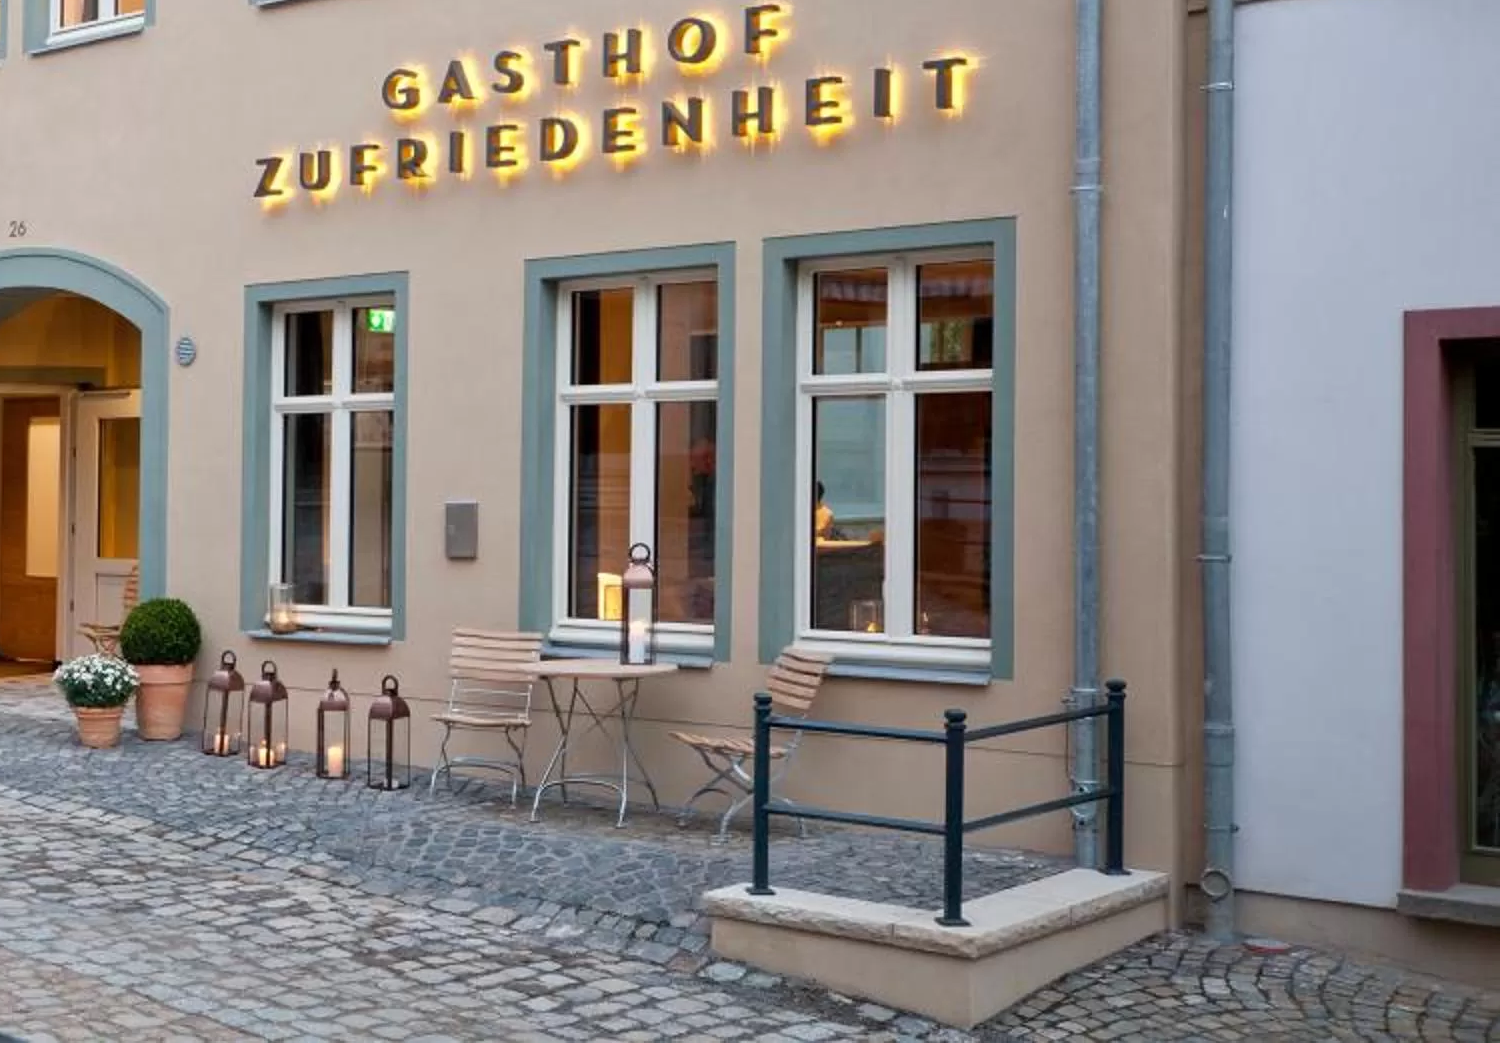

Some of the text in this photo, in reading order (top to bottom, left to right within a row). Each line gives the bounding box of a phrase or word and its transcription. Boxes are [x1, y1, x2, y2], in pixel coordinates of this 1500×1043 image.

[382, 3, 781, 110] GASTHOF
[253, 57, 968, 198] ZUFRIEDENHEIT
[8, 220, 28, 238] 26
